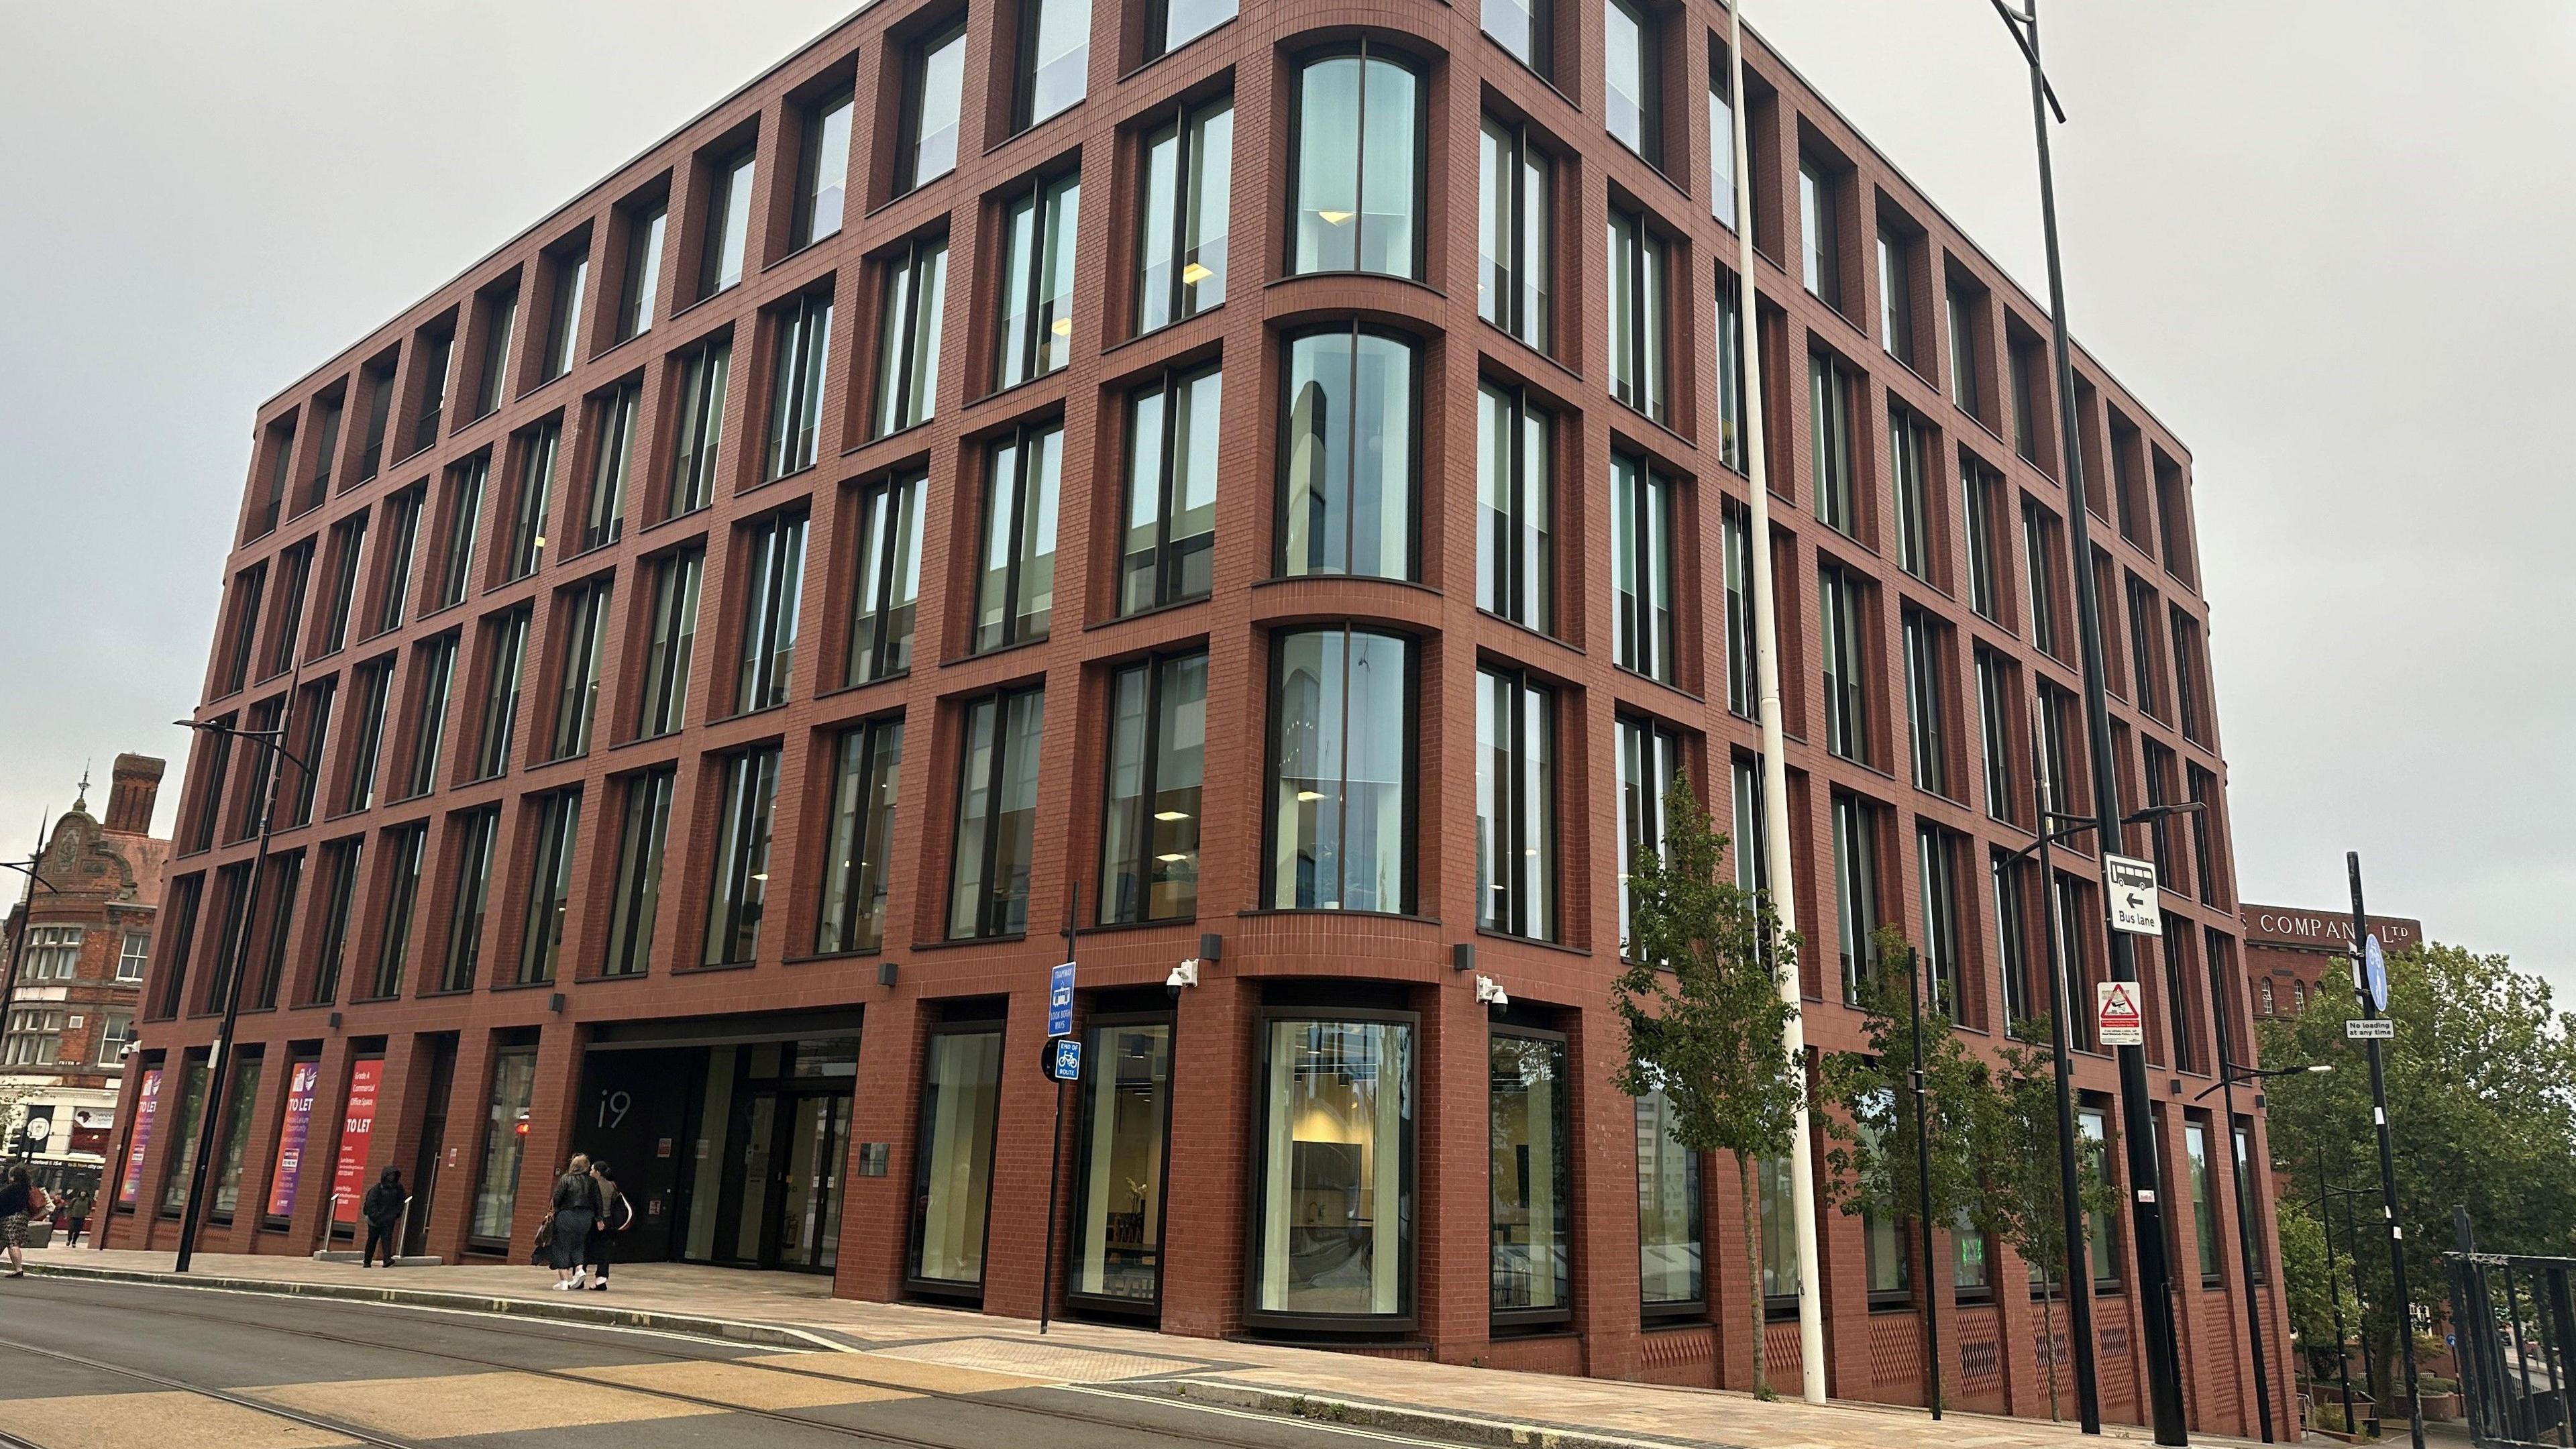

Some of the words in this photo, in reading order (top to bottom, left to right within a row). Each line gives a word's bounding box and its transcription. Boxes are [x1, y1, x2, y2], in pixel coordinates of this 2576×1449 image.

[2118, 910, 2135, 924] Bus
[2137, 913, 2155, 927] lane
[2260, 914, 2367, 939] COMPAN
[1051, 1011, 1059, 1021] LOOK
[1059, 1008, 1071, 1018] BOTH
[1055, 1020, 1065, 1030] WAYS
[354, 1071, 366, 1079] Grade
[1059, 1068, 1075, 1076] ROUTE
[352, 1084, 375, 1092] Commercial
[139, 1101, 147, 1113] TO
[146, 1101, 158, 1113] LET
[288, 1098, 299, 1112] TO
[299, 1098, 314, 1112] LET
[350, 1097, 361, 1106] Office
[361, 1097, 373, 1108] Space
[598, 1089, 631, 1128] i9
[346, 1118, 356, 1132] TO
[356, 1118, 372, 1132] LET
